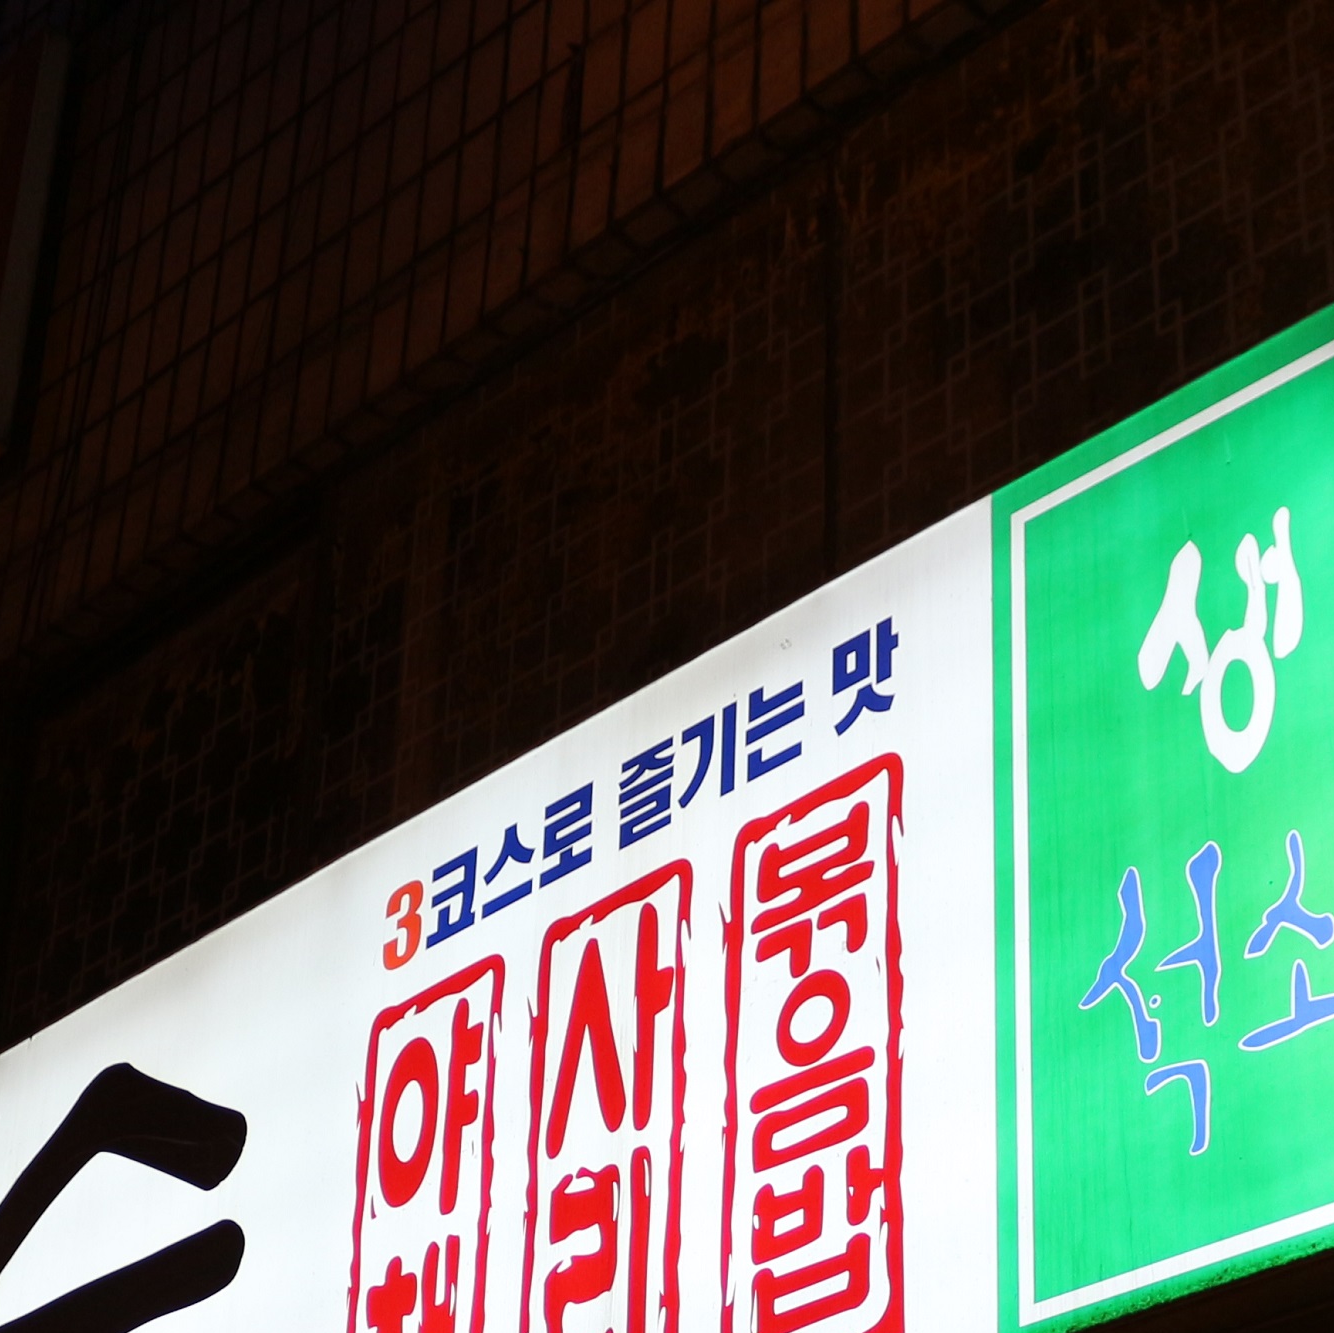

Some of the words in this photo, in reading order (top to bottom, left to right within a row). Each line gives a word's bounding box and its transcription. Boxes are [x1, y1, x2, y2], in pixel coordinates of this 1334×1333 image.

[1139, 507, 1302, 771] 생
[382, 782, 594, 972] 3코스로
[618, 679, 806, 851] 즐기는
[832, 618, 897, 736] 맛
